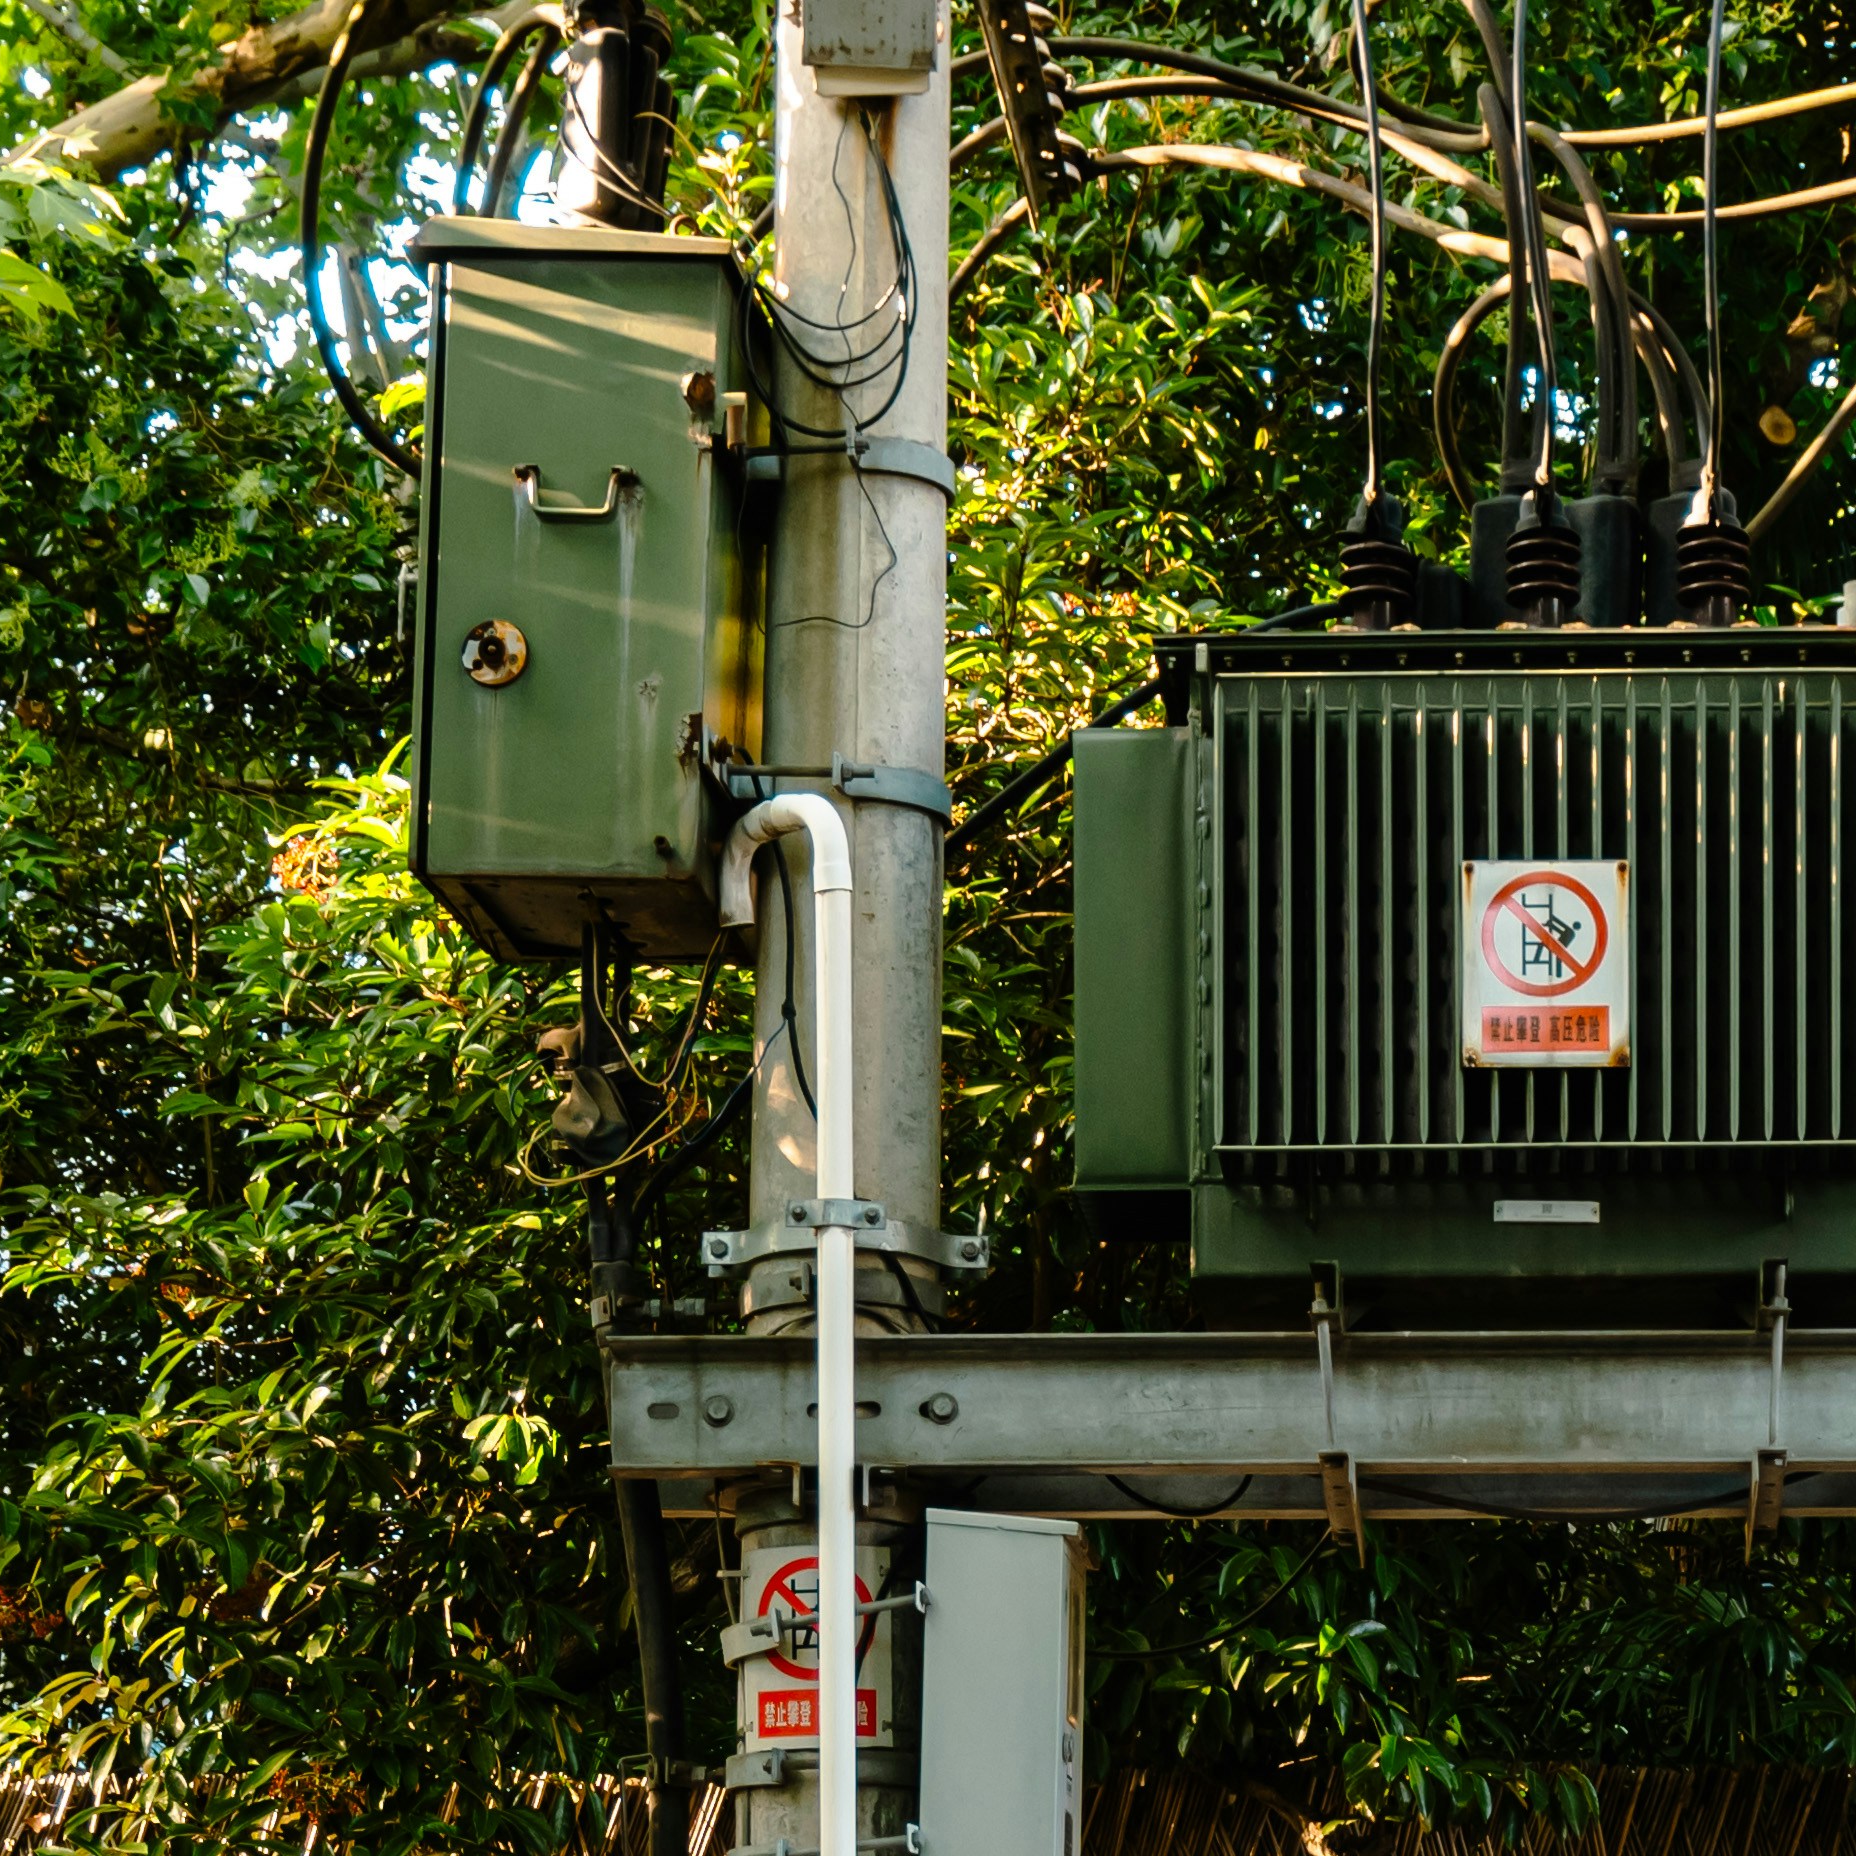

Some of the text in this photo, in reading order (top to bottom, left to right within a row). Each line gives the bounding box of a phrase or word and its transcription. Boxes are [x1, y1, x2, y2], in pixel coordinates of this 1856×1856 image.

[1491, 1015, 1600, 1043] 禁止攀登 高压危险
[764, 1699, 811, 1728] 禁止攀登
